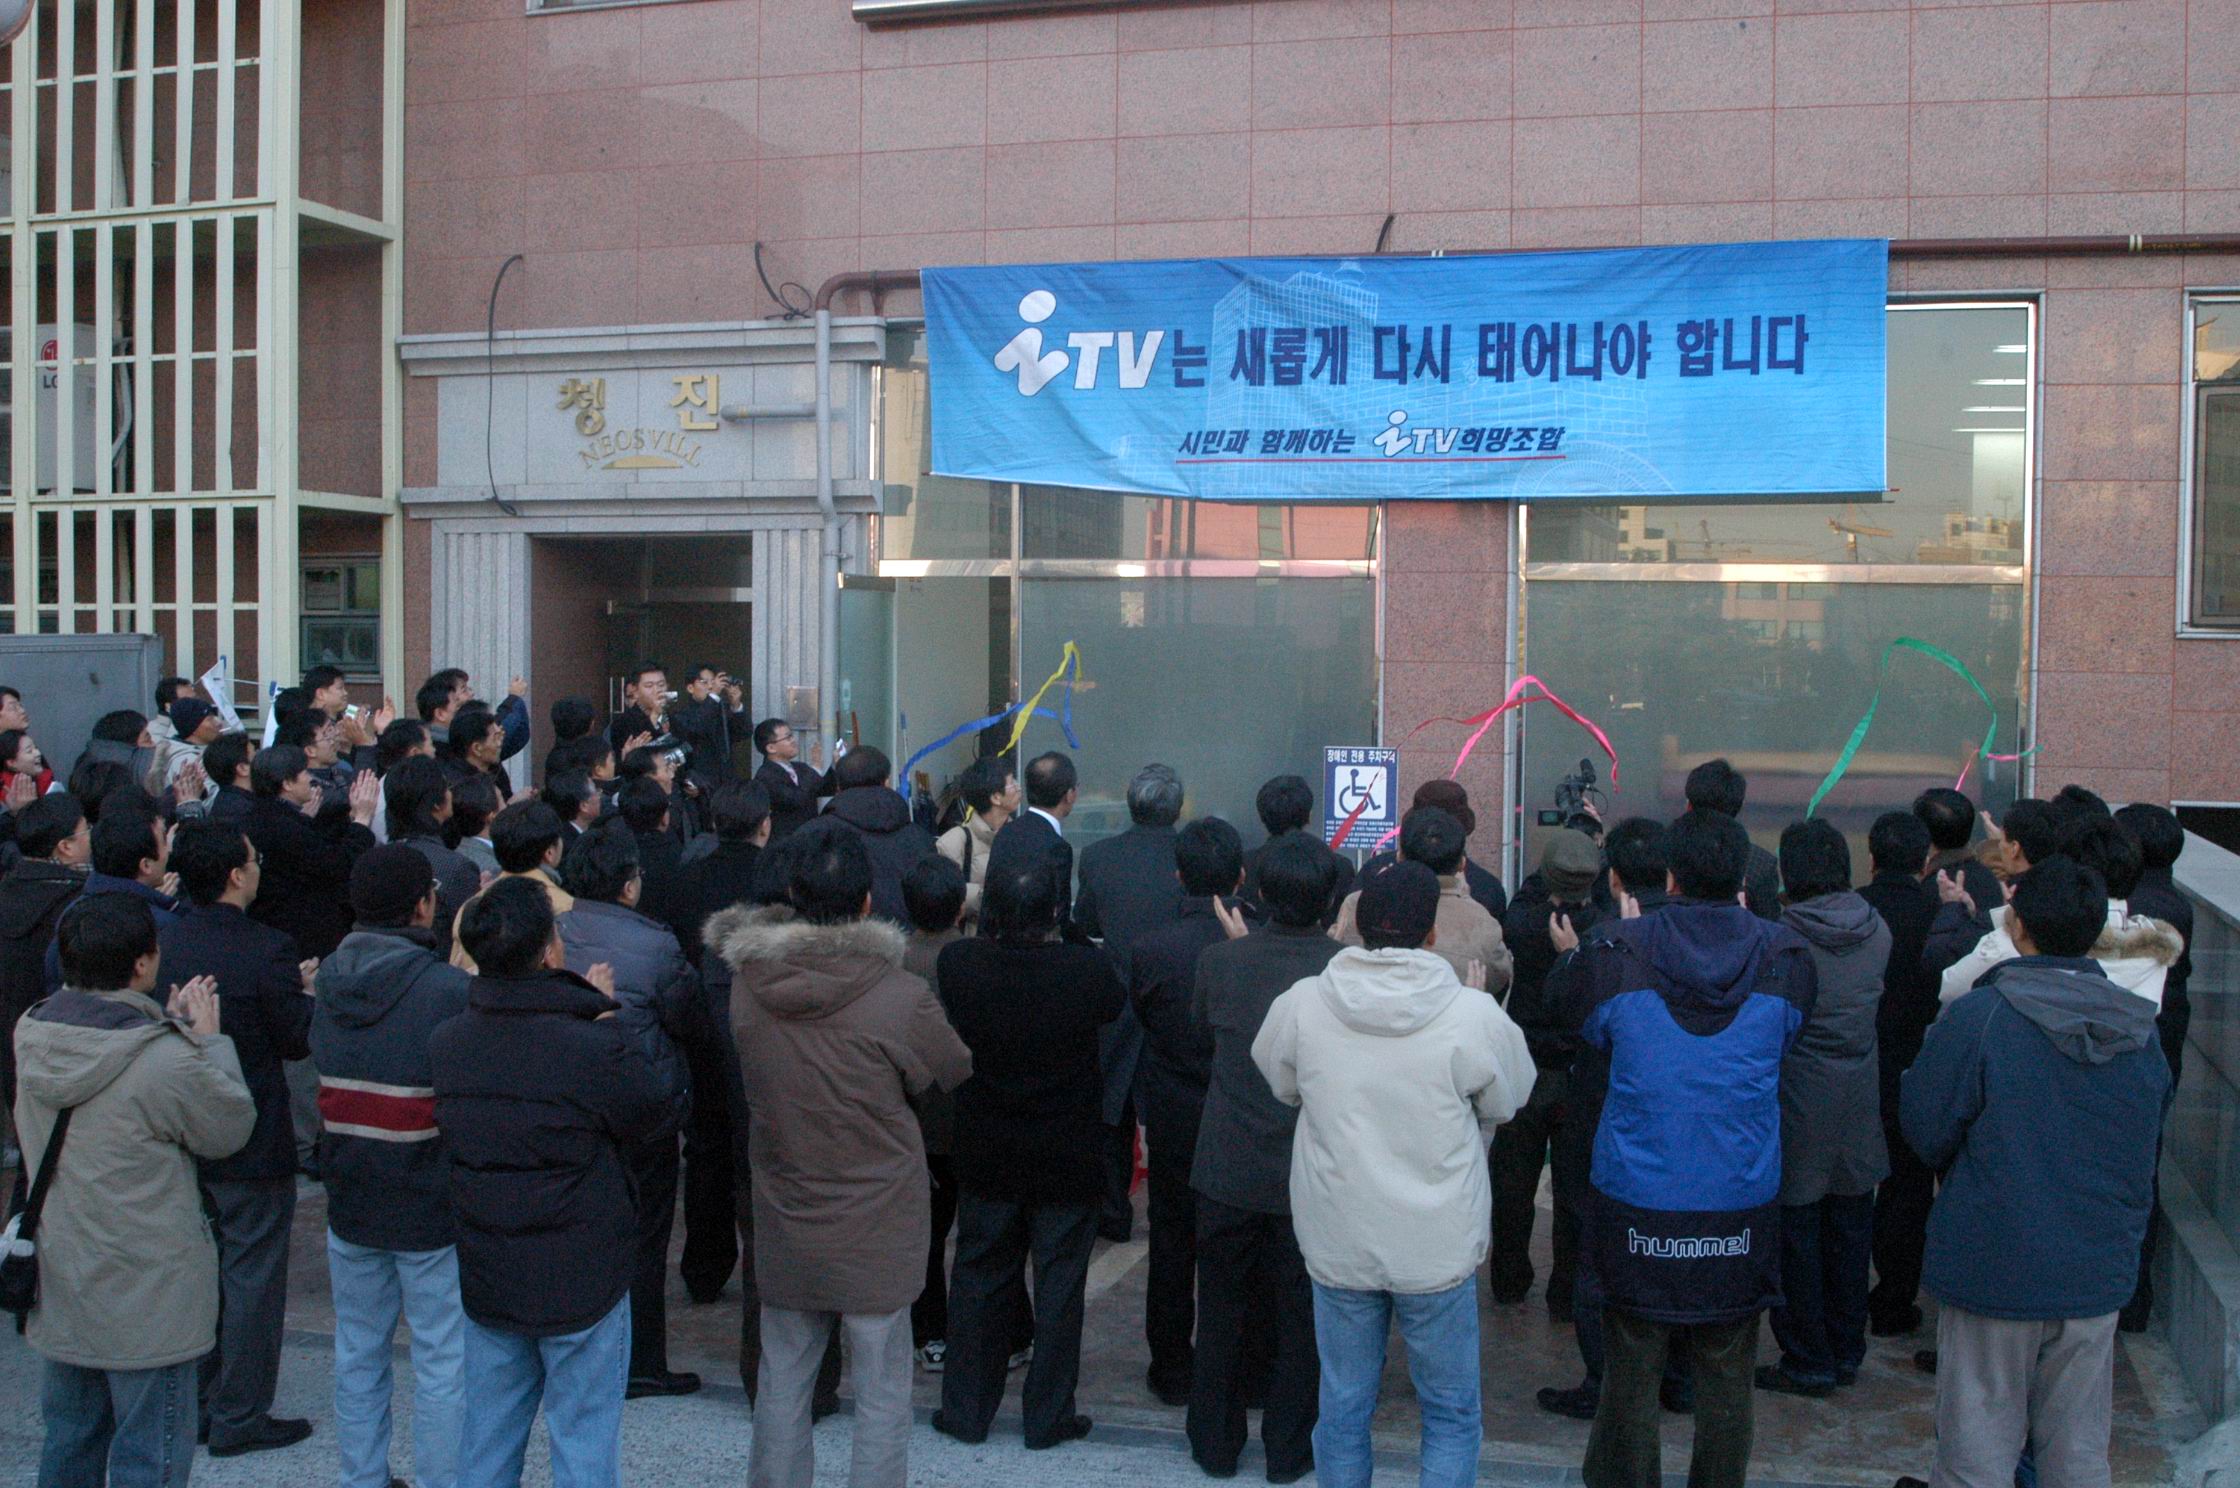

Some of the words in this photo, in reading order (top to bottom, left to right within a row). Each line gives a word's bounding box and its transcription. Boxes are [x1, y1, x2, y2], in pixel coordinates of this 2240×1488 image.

[994, 289, 1208, 397] iTV는
[1230, 325, 1348, 387] 새롭게
[1373, 323, 1452, 385] 다시
[1478, 319, 1652, 383] 태어나야
[1676, 313, 1809, 378] 합니다
[579, 428, 702, 470] NEOSVILL
[1178, 429, 1250, 455] 시민과
[1260, 429, 1356, 454] 함께하는
[1327, 749, 1348, 763] 장애인
[1628, 1227, 1751, 1258] hummel
